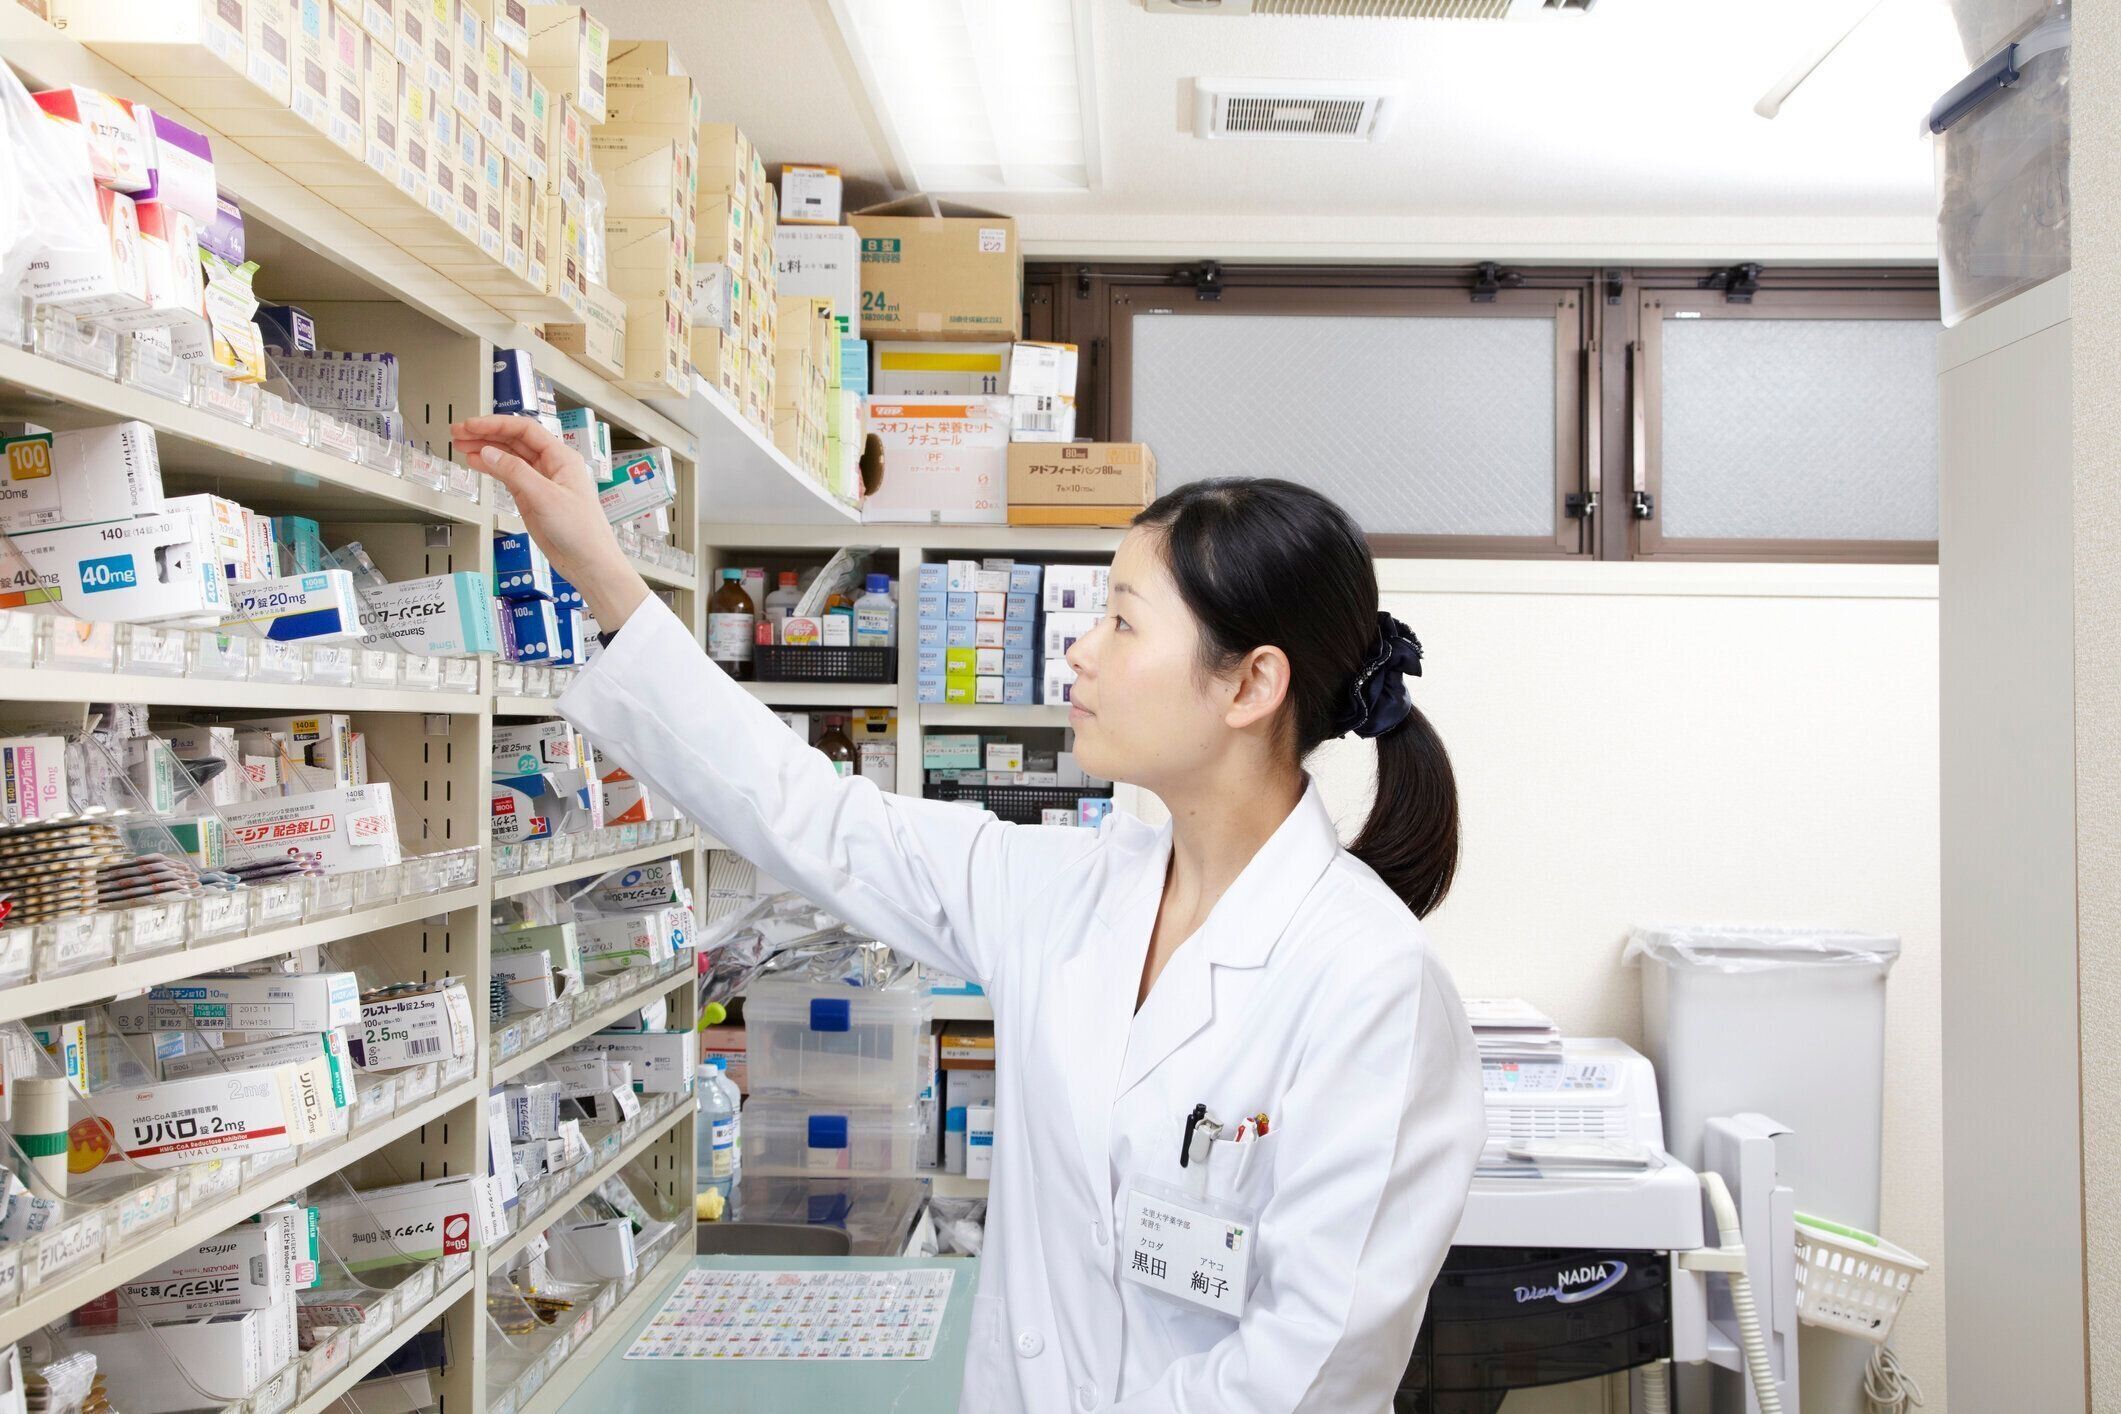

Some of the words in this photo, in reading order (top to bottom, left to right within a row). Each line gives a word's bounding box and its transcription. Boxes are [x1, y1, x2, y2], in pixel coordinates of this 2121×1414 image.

[983, 241, 1002, 251] ピンク
[34, 281, 61, 289] Novartis
[862, 291, 886, 311] 24
[888, 303, 900, 312] ml
[297, 317, 312, 340] 5mg
[498, 398, 521, 408] astellas
[877, 422, 935, 433] ネオフィード
[938, 421, 993, 434] 栄養セット
[908, 434, 962, 446] ナチュール
[13, 443, 46, 469] 100
[928, 453, 943, 461] PF
[81, 563, 136, 586] 40mg
[362, 633, 377, 645] OD
[429, 640, 457, 652] 15mg
[296, 721, 316, 730] 140錠
[520, 758, 536, 771] 25
[43, 766, 58, 803] 16mg
[346, 790, 365, 799] 140錠
[273, 816, 331, 839] 配合錠LD
[646, 866, 663, 880] 30
[670, 914, 679, 926] 20
[210, 989, 229, 1000] 10mg
[365, 1028, 409, 1044] 2.5mg
[228, 1079, 271, 1101] 2mg
[159, 1143, 190, 1153] HMG-CoA
[190, 1138, 221, 1149] Reductase
[222, 1134, 248, 1144] Inhibitor
[177, 1146, 219, 1160] LIVALO
[233, 1142, 250, 1152] 2mg
[308, 1211, 316, 1238] FUJIFILM
[1140, 1217, 1161, 1232] 実習生
[1142, 1206, 1191, 1230] 北里大学薬学部
[394, 1222, 435, 1238] ケンタン
[352, 1231, 377, 1244] 60mg
[445, 1239, 467, 1250] 60mg
[1140, 1237, 1164, 1251] クロダ
[199, 1244, 237, 1256] alfresa
[202, 1263, 239, 1273] NIPOLAZIN
[1200, 1257, 1224, 1272] アヤコ
[301, 1263, 313, 1282] 100
[1132, 1249, 1167, 1280] 黒田
[1190, 1270, 1229, 1299] 絢子
[1557, 1264, 1607, 1286] NADIA
